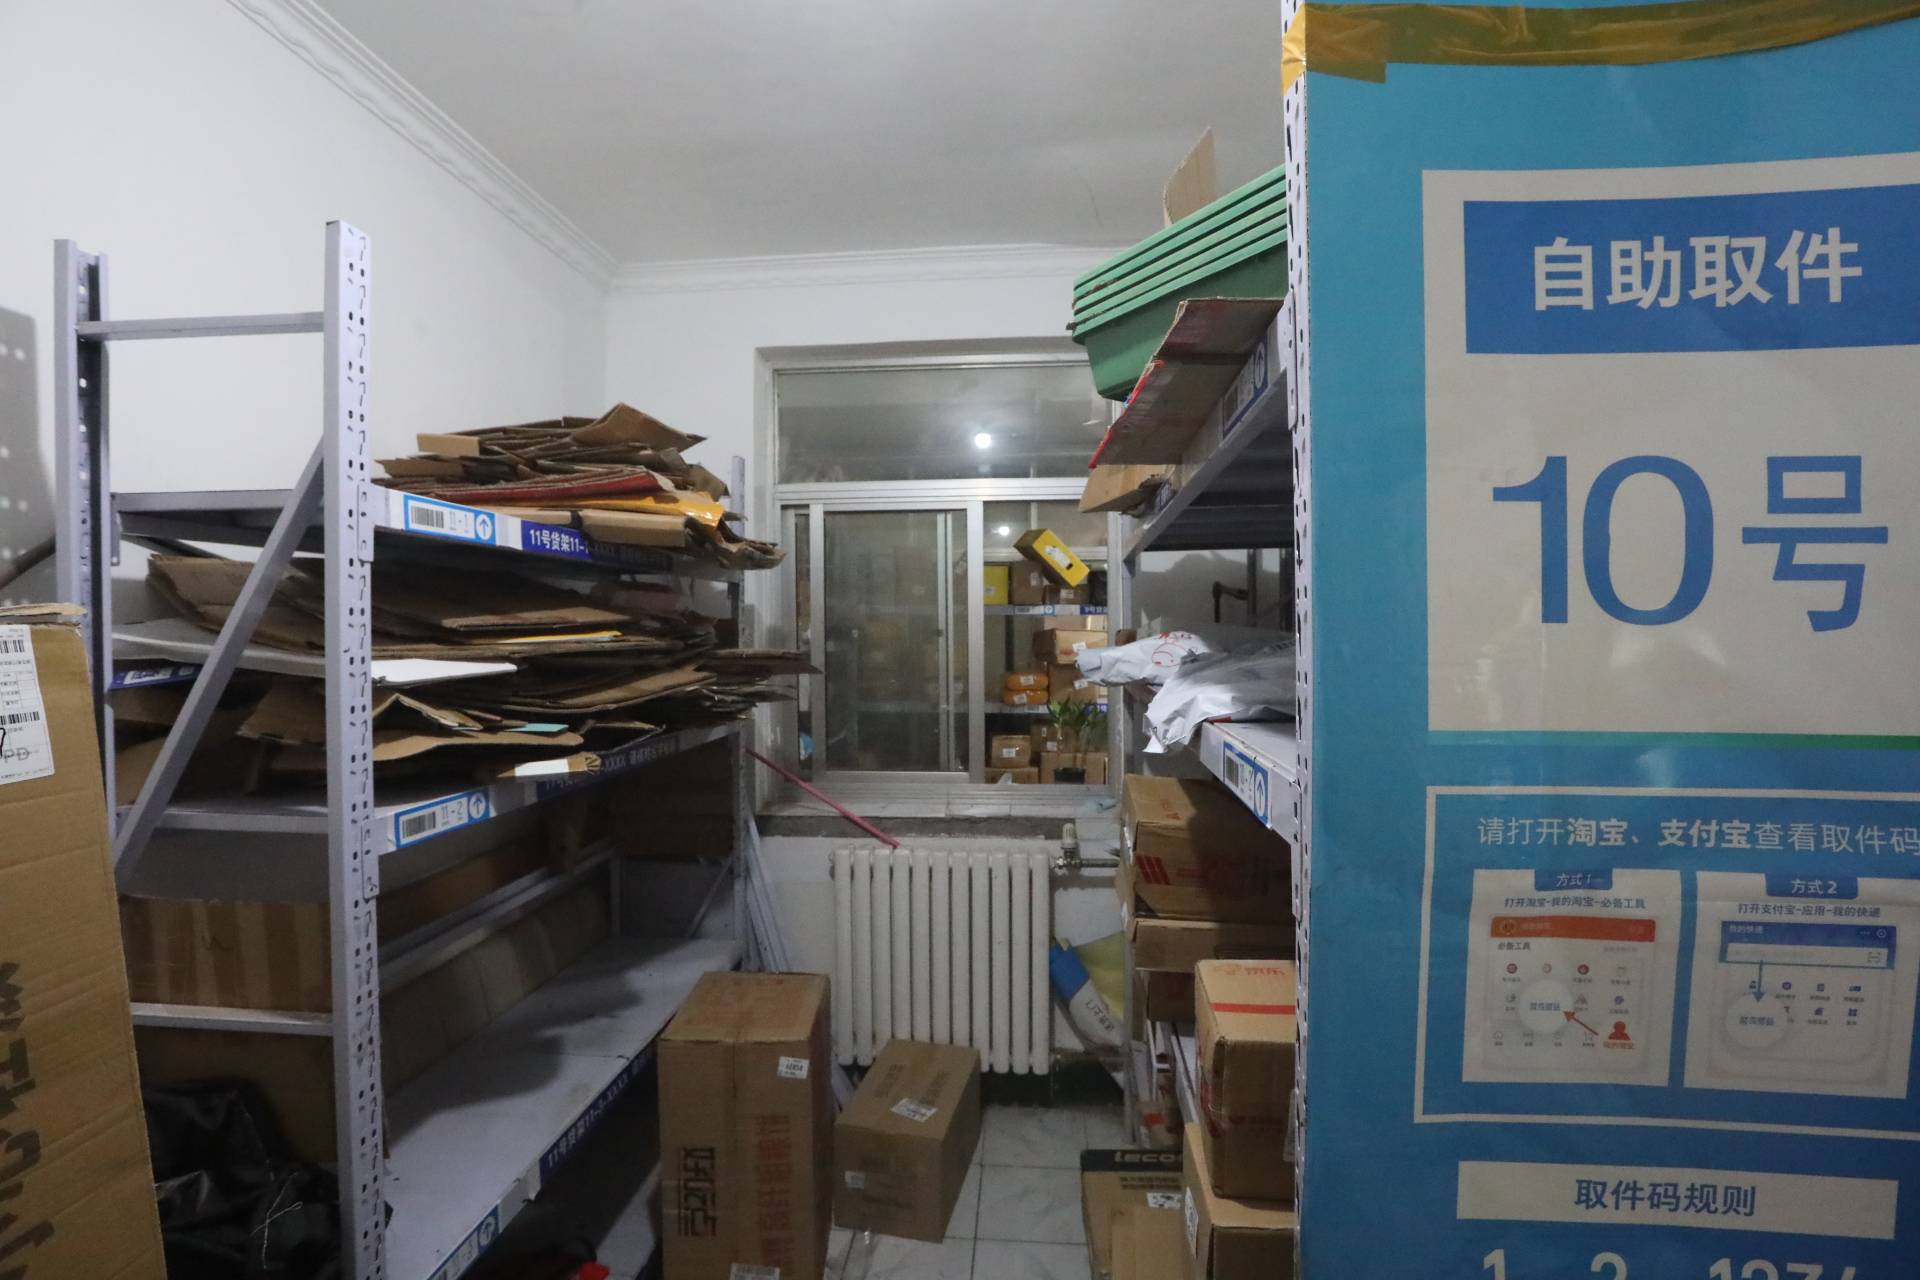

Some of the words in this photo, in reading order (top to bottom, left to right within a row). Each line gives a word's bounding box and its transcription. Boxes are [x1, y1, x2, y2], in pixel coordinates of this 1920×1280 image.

[1533, 226, 1863, 311] 自助取件
[1492, 455, 1889, 632] 10号
[1478, 816, 1920, 855] 请打开淘宝、支付宝查看取件码
[1737, 903, 1881, 918] 打开支付宝-应用-我的快递
[1574, 1179, 1757, 1217] 取件码规则
